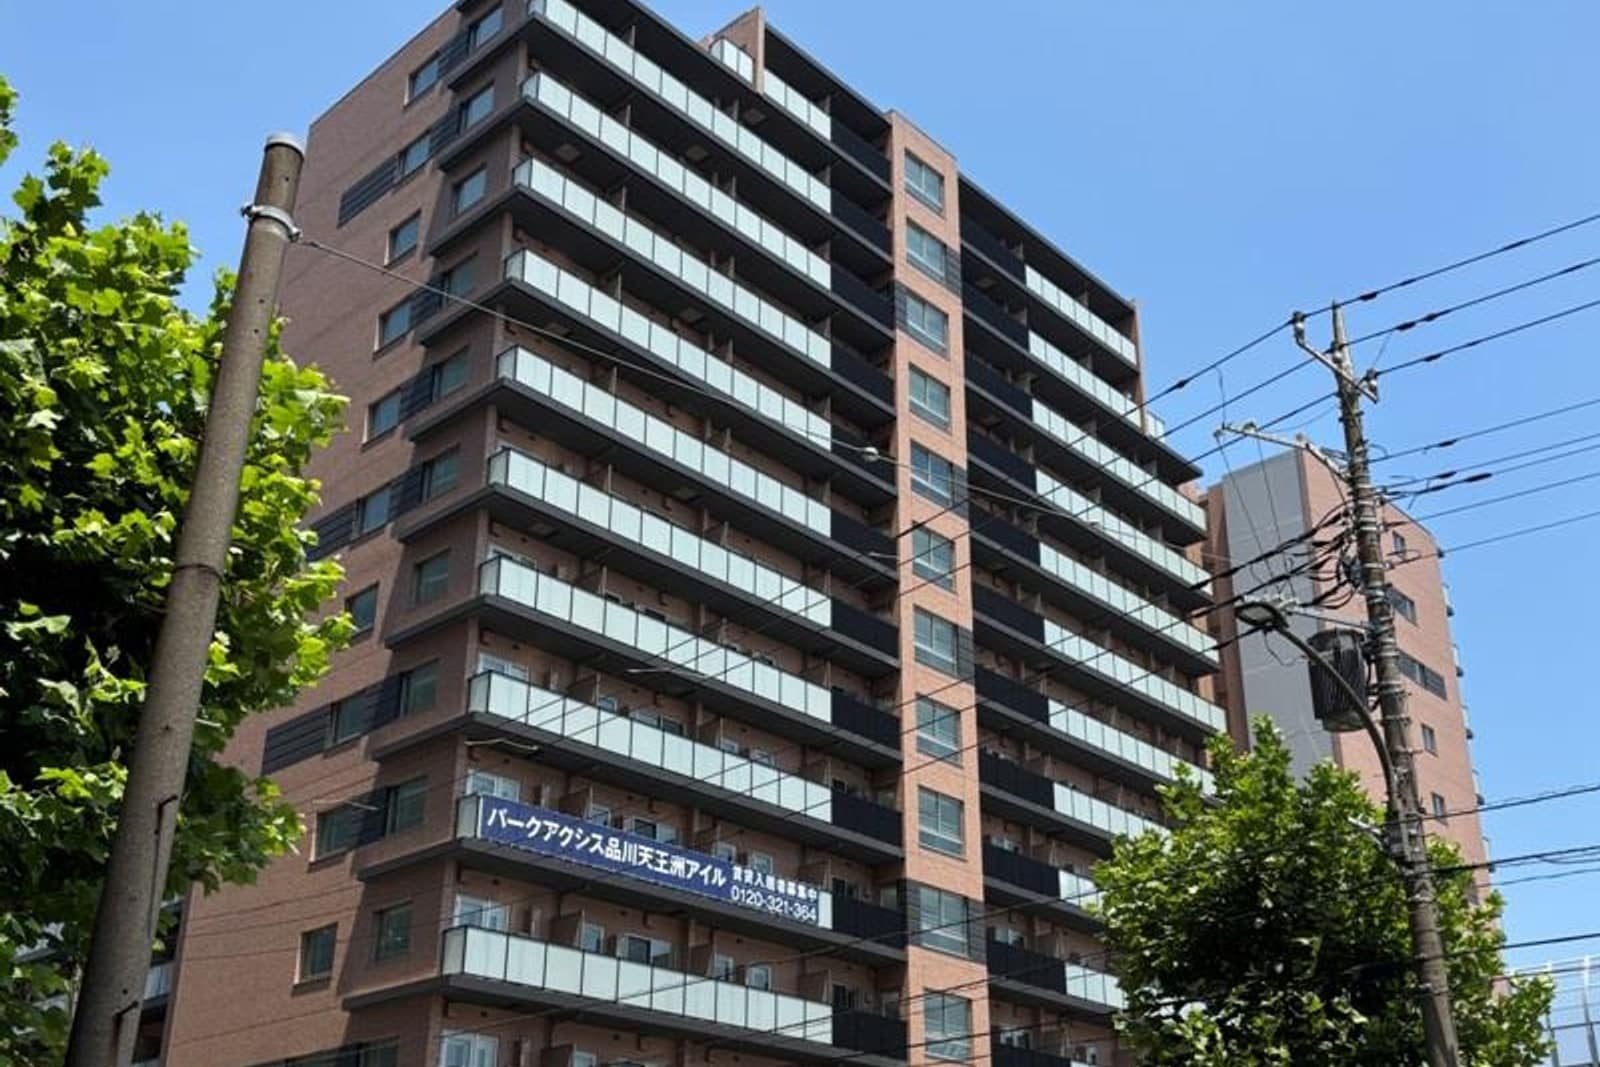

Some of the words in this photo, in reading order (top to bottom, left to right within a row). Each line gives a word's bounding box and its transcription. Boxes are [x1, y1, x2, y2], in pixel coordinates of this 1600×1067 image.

[487, 808, 726, 888] パークアクシス品川天王洲アイル
[730, 885, 817, 921] 0120-321-364
